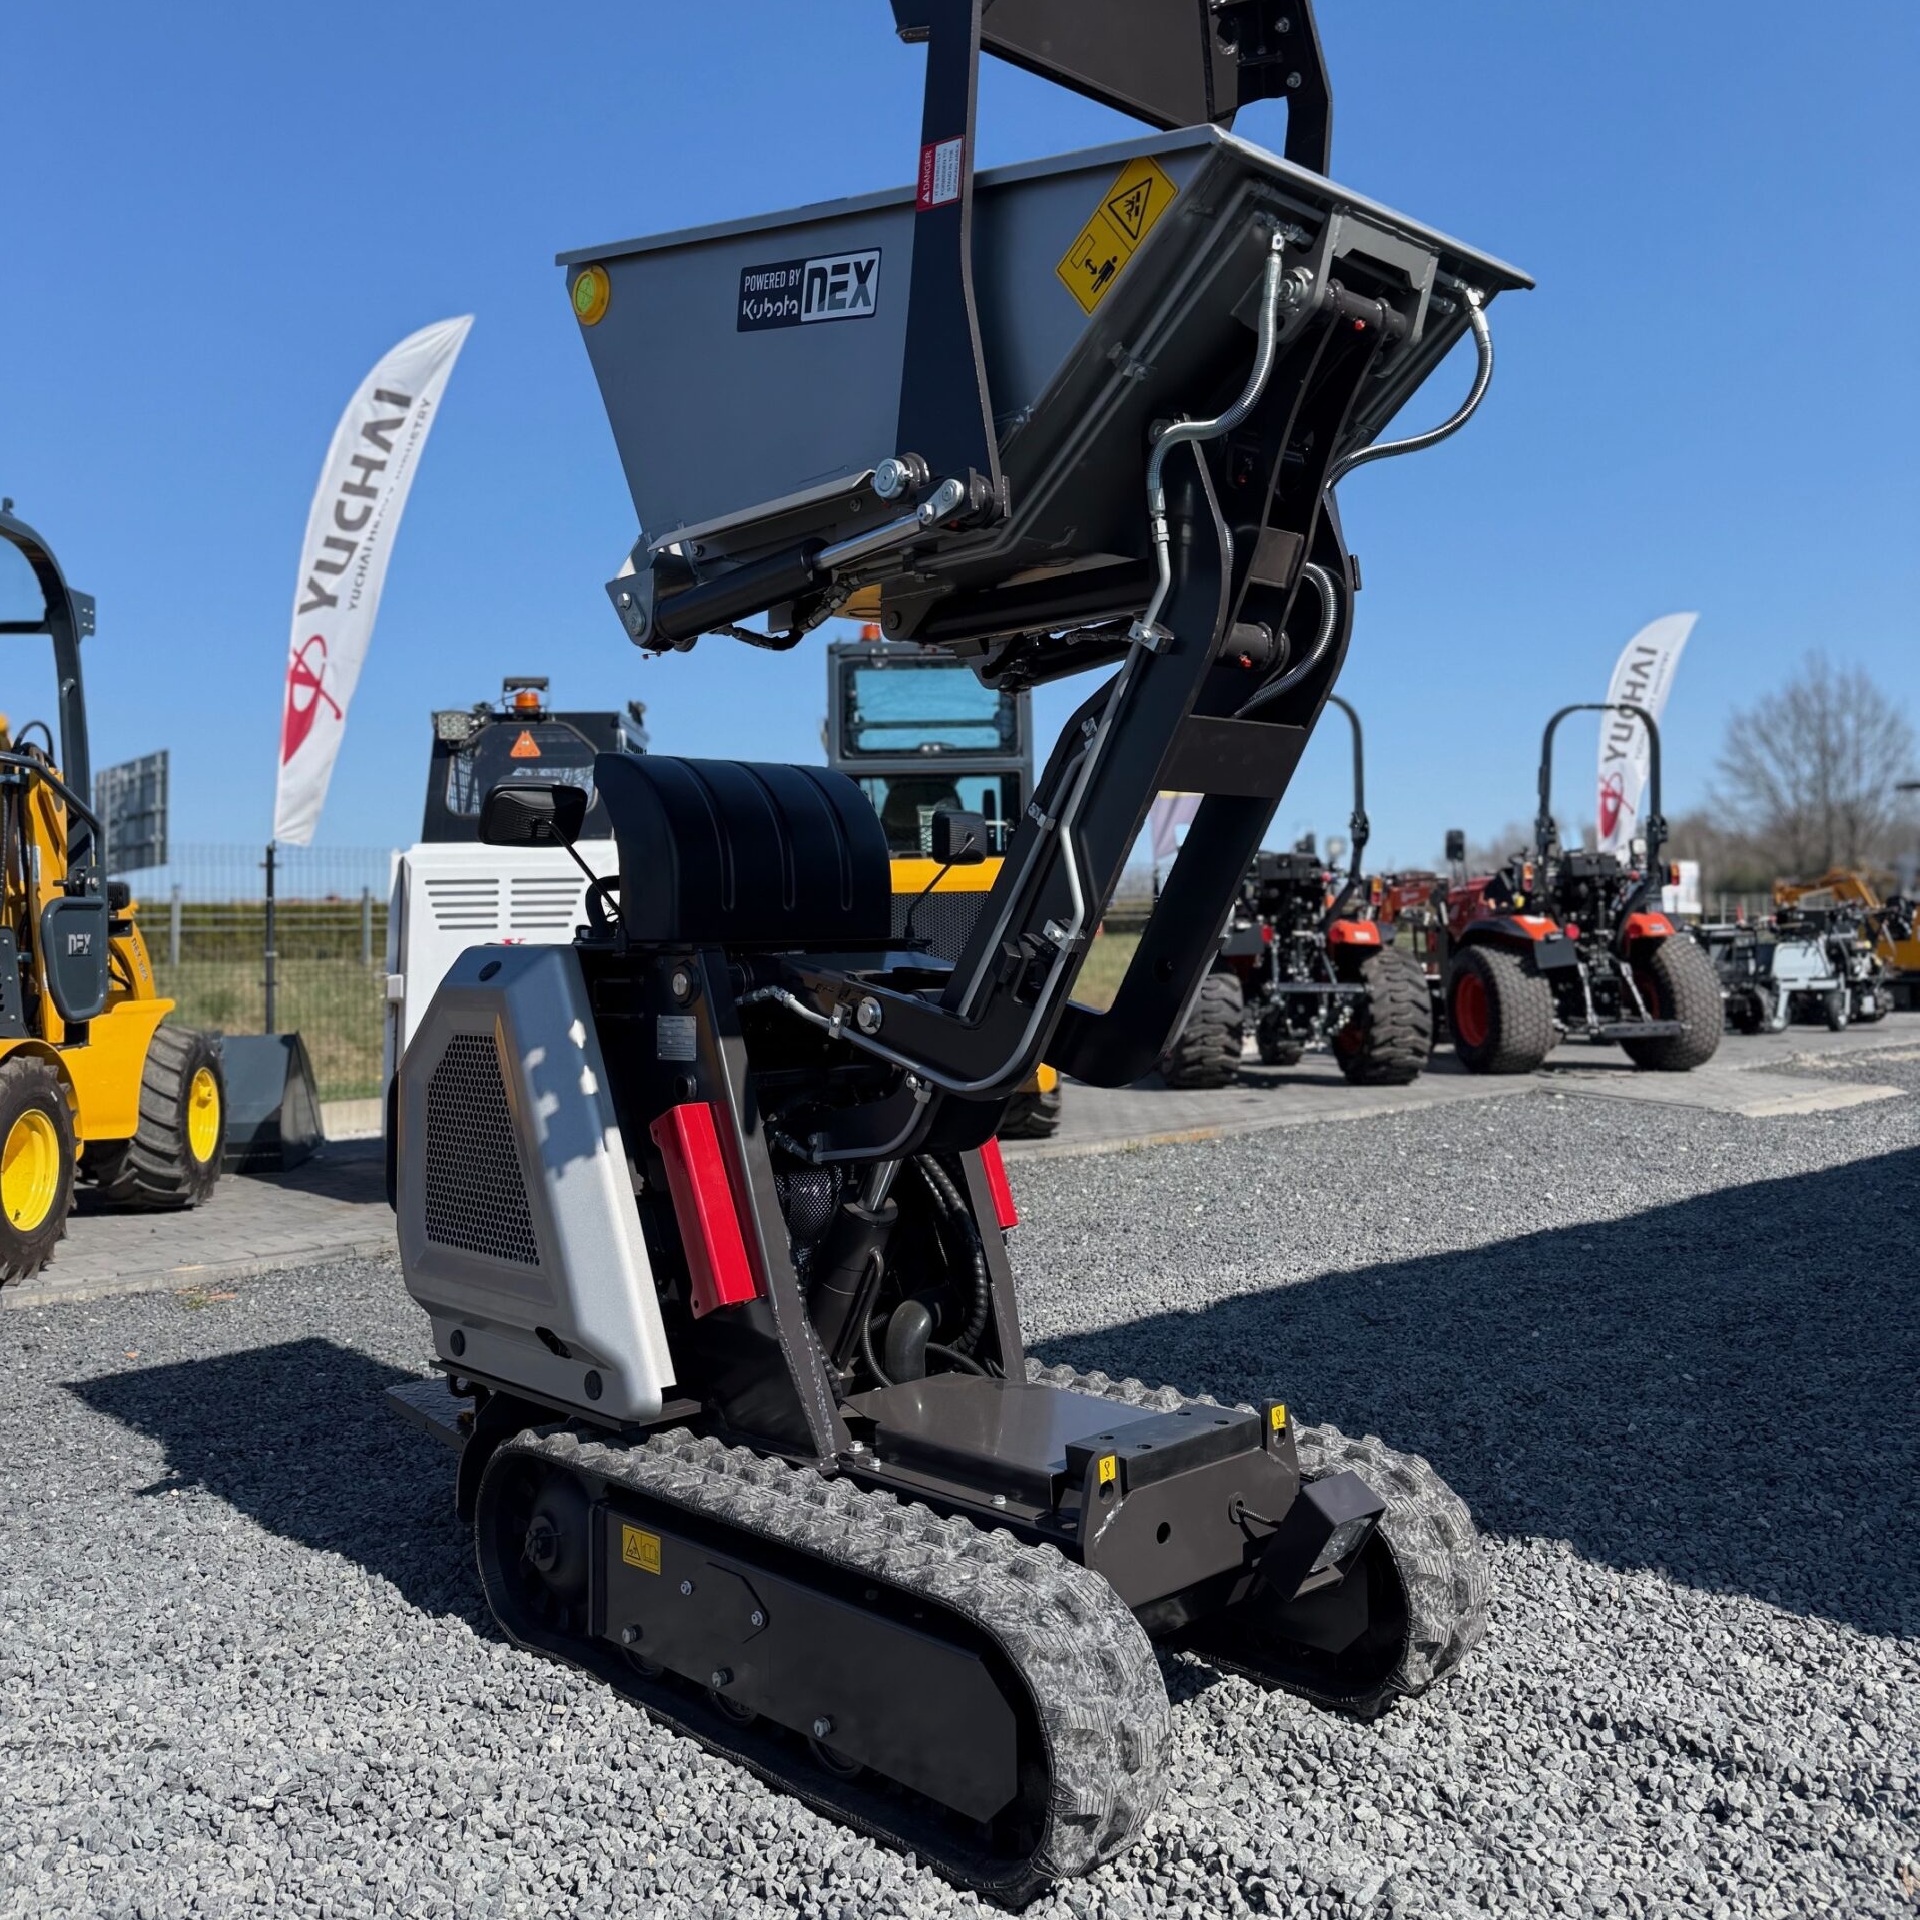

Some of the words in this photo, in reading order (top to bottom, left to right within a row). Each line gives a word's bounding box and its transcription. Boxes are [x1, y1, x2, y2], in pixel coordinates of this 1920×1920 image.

[922, 149, 932, 191] DANGER
[744, 271, 786, 293] POWERED
[788, 268, 802, 287] BY
[804, 259, 876, 314] NEX
[742, 294, 799, 320] Kubota
[297, 388, 412, 616] YUCHAI
[348, 546, 373, 611] YUCHAI
[68, 933, 92, 956] NEX
